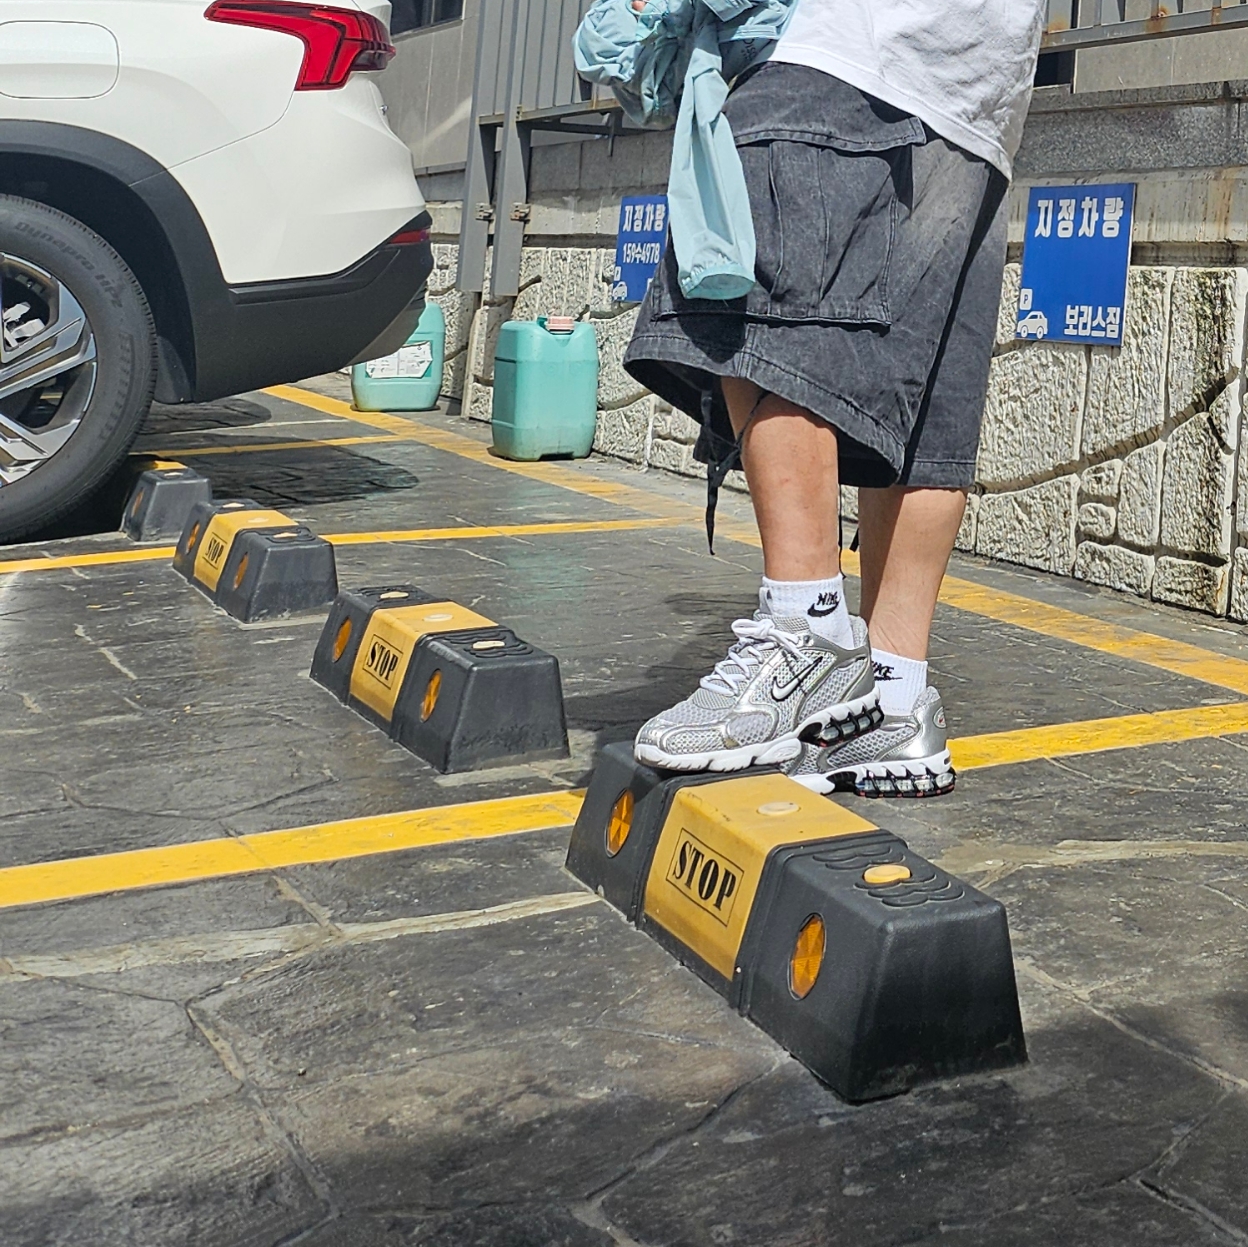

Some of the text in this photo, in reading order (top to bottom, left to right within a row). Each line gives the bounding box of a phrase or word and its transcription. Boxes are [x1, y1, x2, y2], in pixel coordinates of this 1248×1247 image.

[623, 204, 665, 232] 지정차량
[1035, 197, 1124, 238] 지정차량
[205, 537, 224, 564] STOP
[366, 641, 399, 681] STOP
[672, 840, 737, 912] STOP
